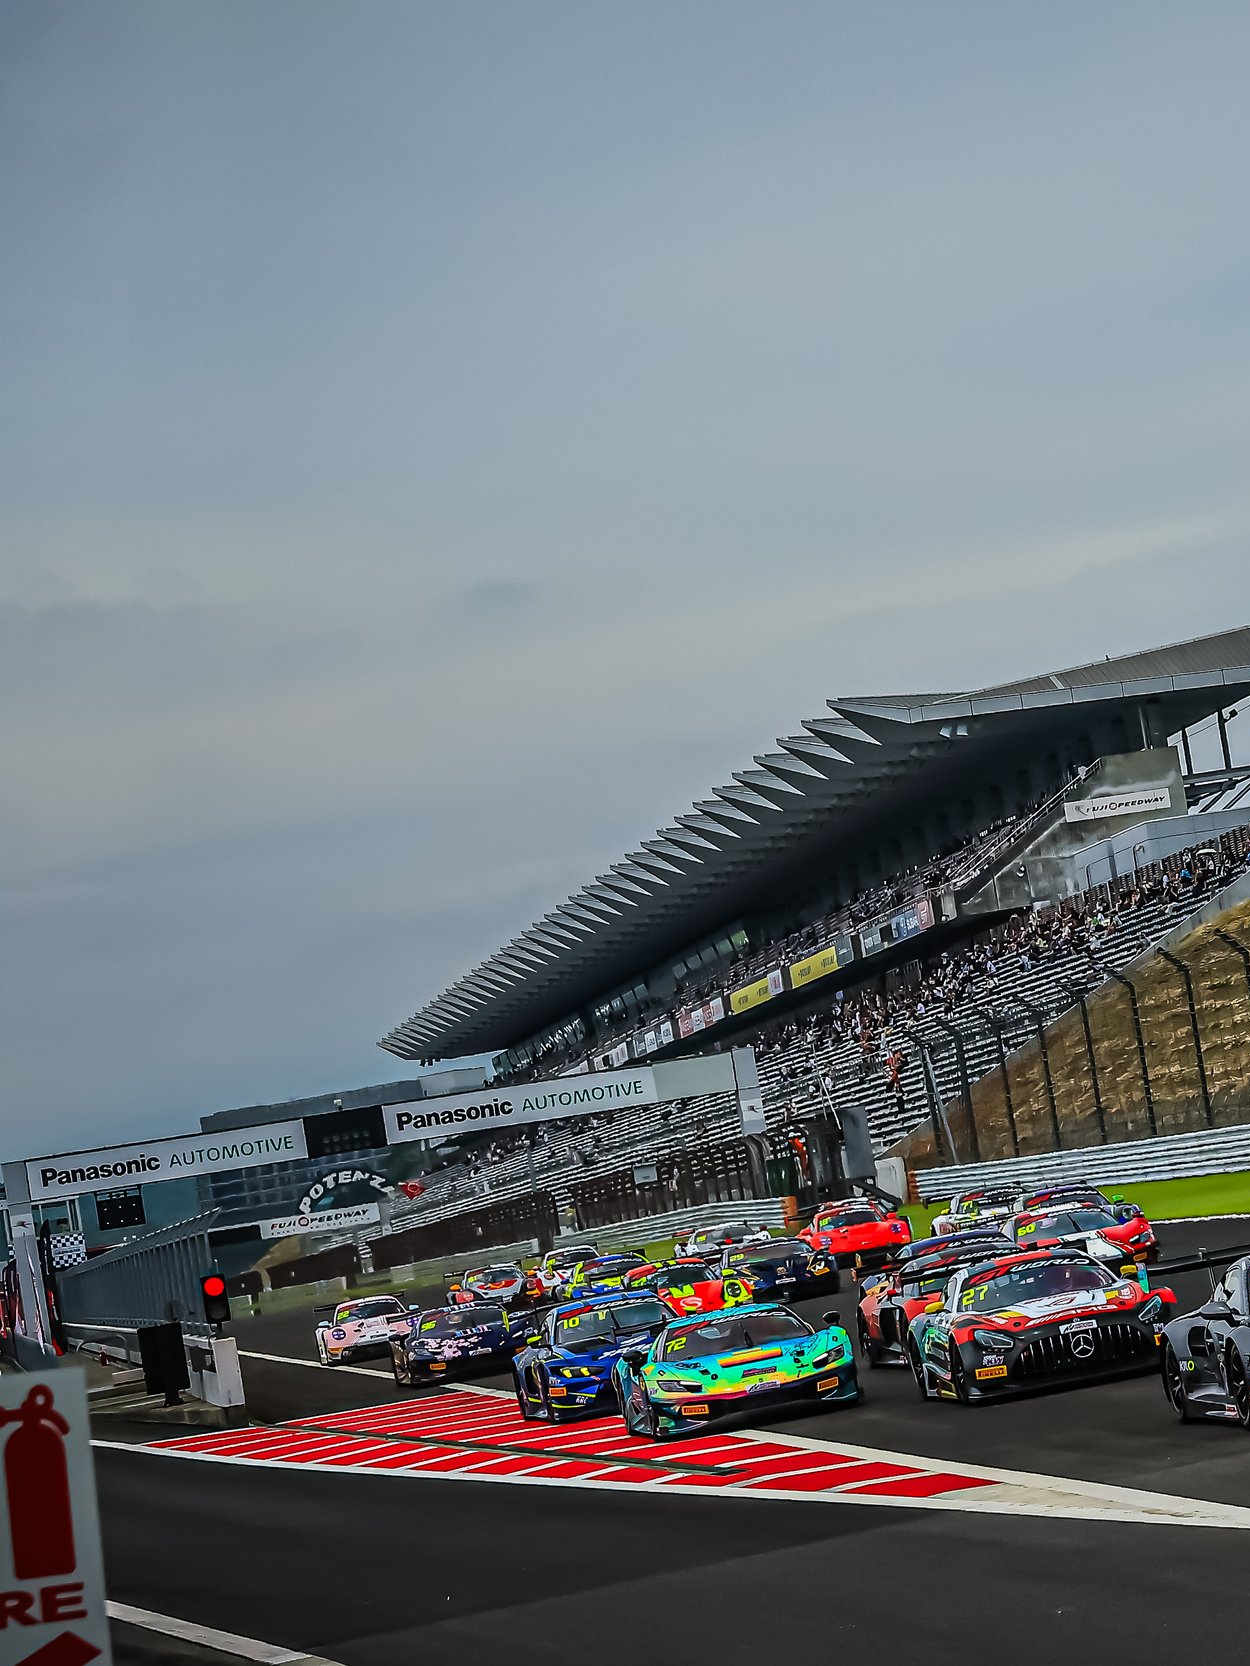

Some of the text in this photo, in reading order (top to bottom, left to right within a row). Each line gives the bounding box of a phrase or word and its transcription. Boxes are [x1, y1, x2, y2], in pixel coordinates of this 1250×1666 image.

[396, 1079, 644, 1131] Panasonic AUTOMOTIVE
[41, 1135, 294, 1187] Panasonic AUTOMOTIVE
[1017, 1224, 1036, 1237] 60
[1009, 1257, 1090, 1273] WORLD
[962, 1285, 989, 1306] 27
[563, 1317, 580, 1330] 10
[666, 1337, 687, 1353] 72
